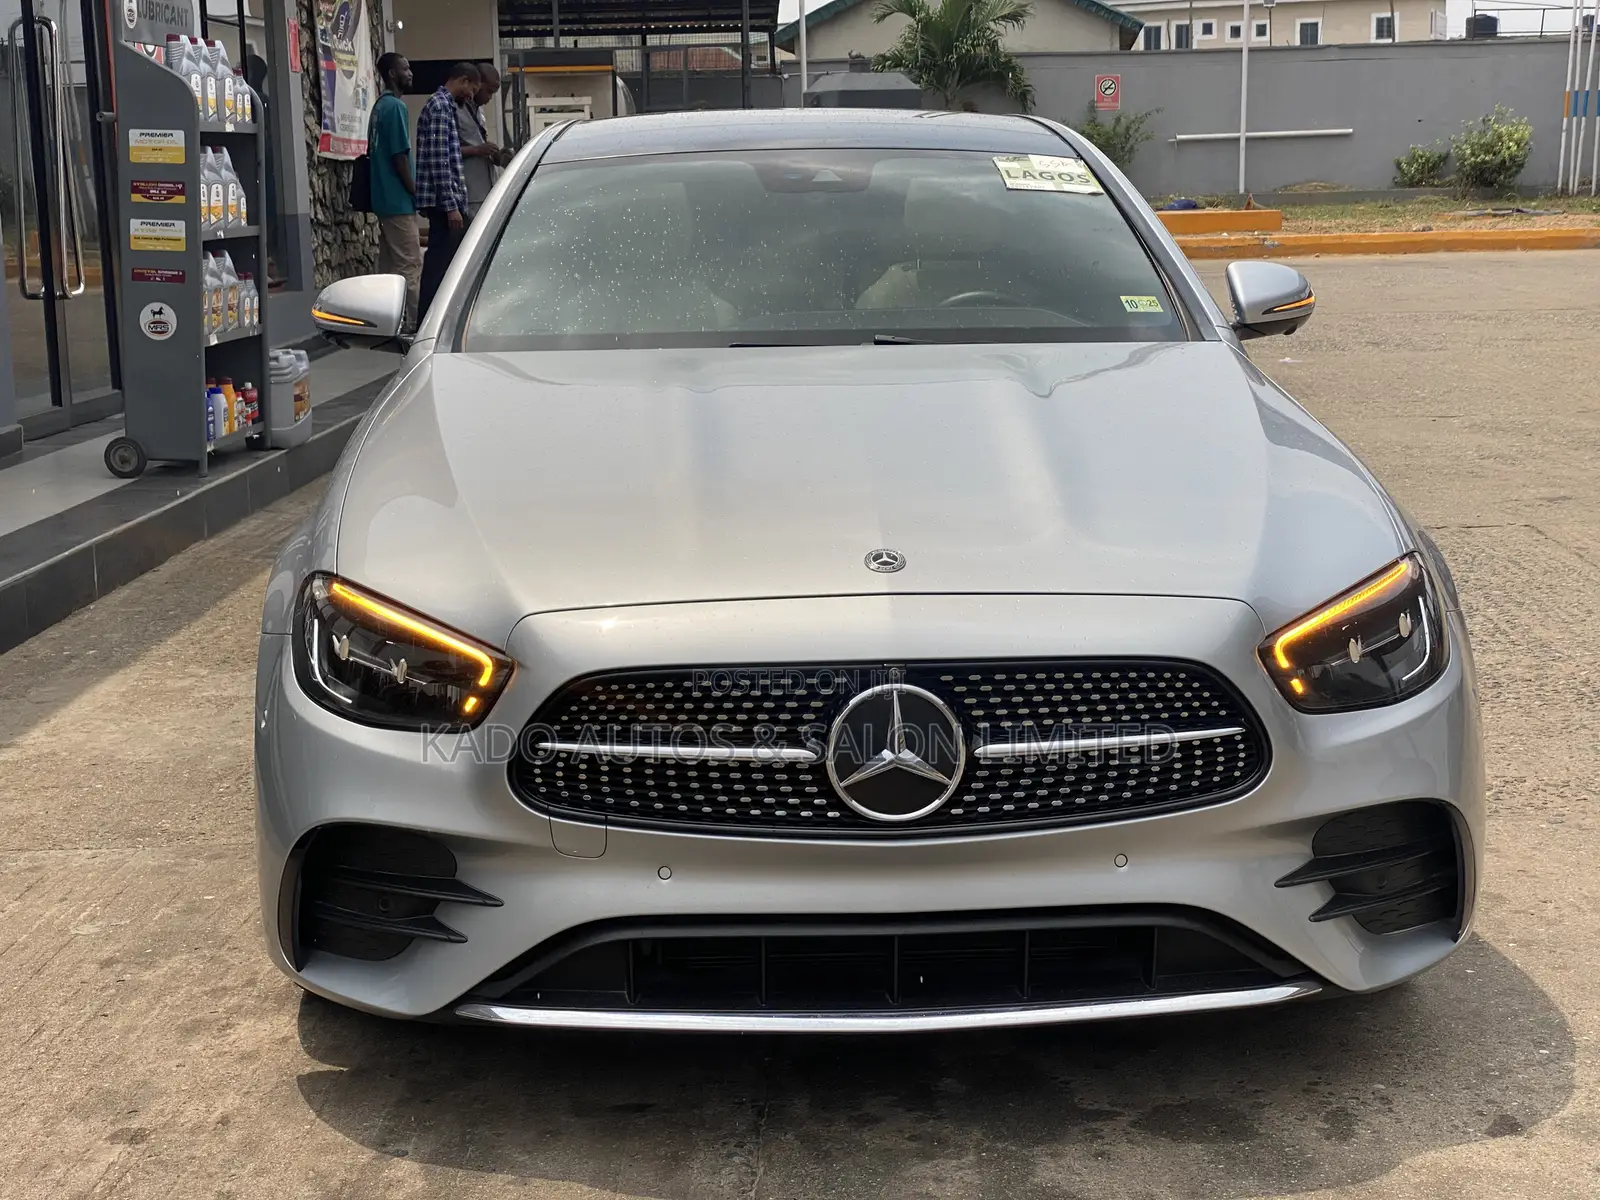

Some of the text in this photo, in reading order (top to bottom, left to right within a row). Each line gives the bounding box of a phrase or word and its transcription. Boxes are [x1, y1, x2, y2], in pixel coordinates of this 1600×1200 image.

[1004, 169, 1091, 184] LAGOS
[140, 220, 176, 228] PREMIER
[1125, 299, 1159, 309] 10 25
